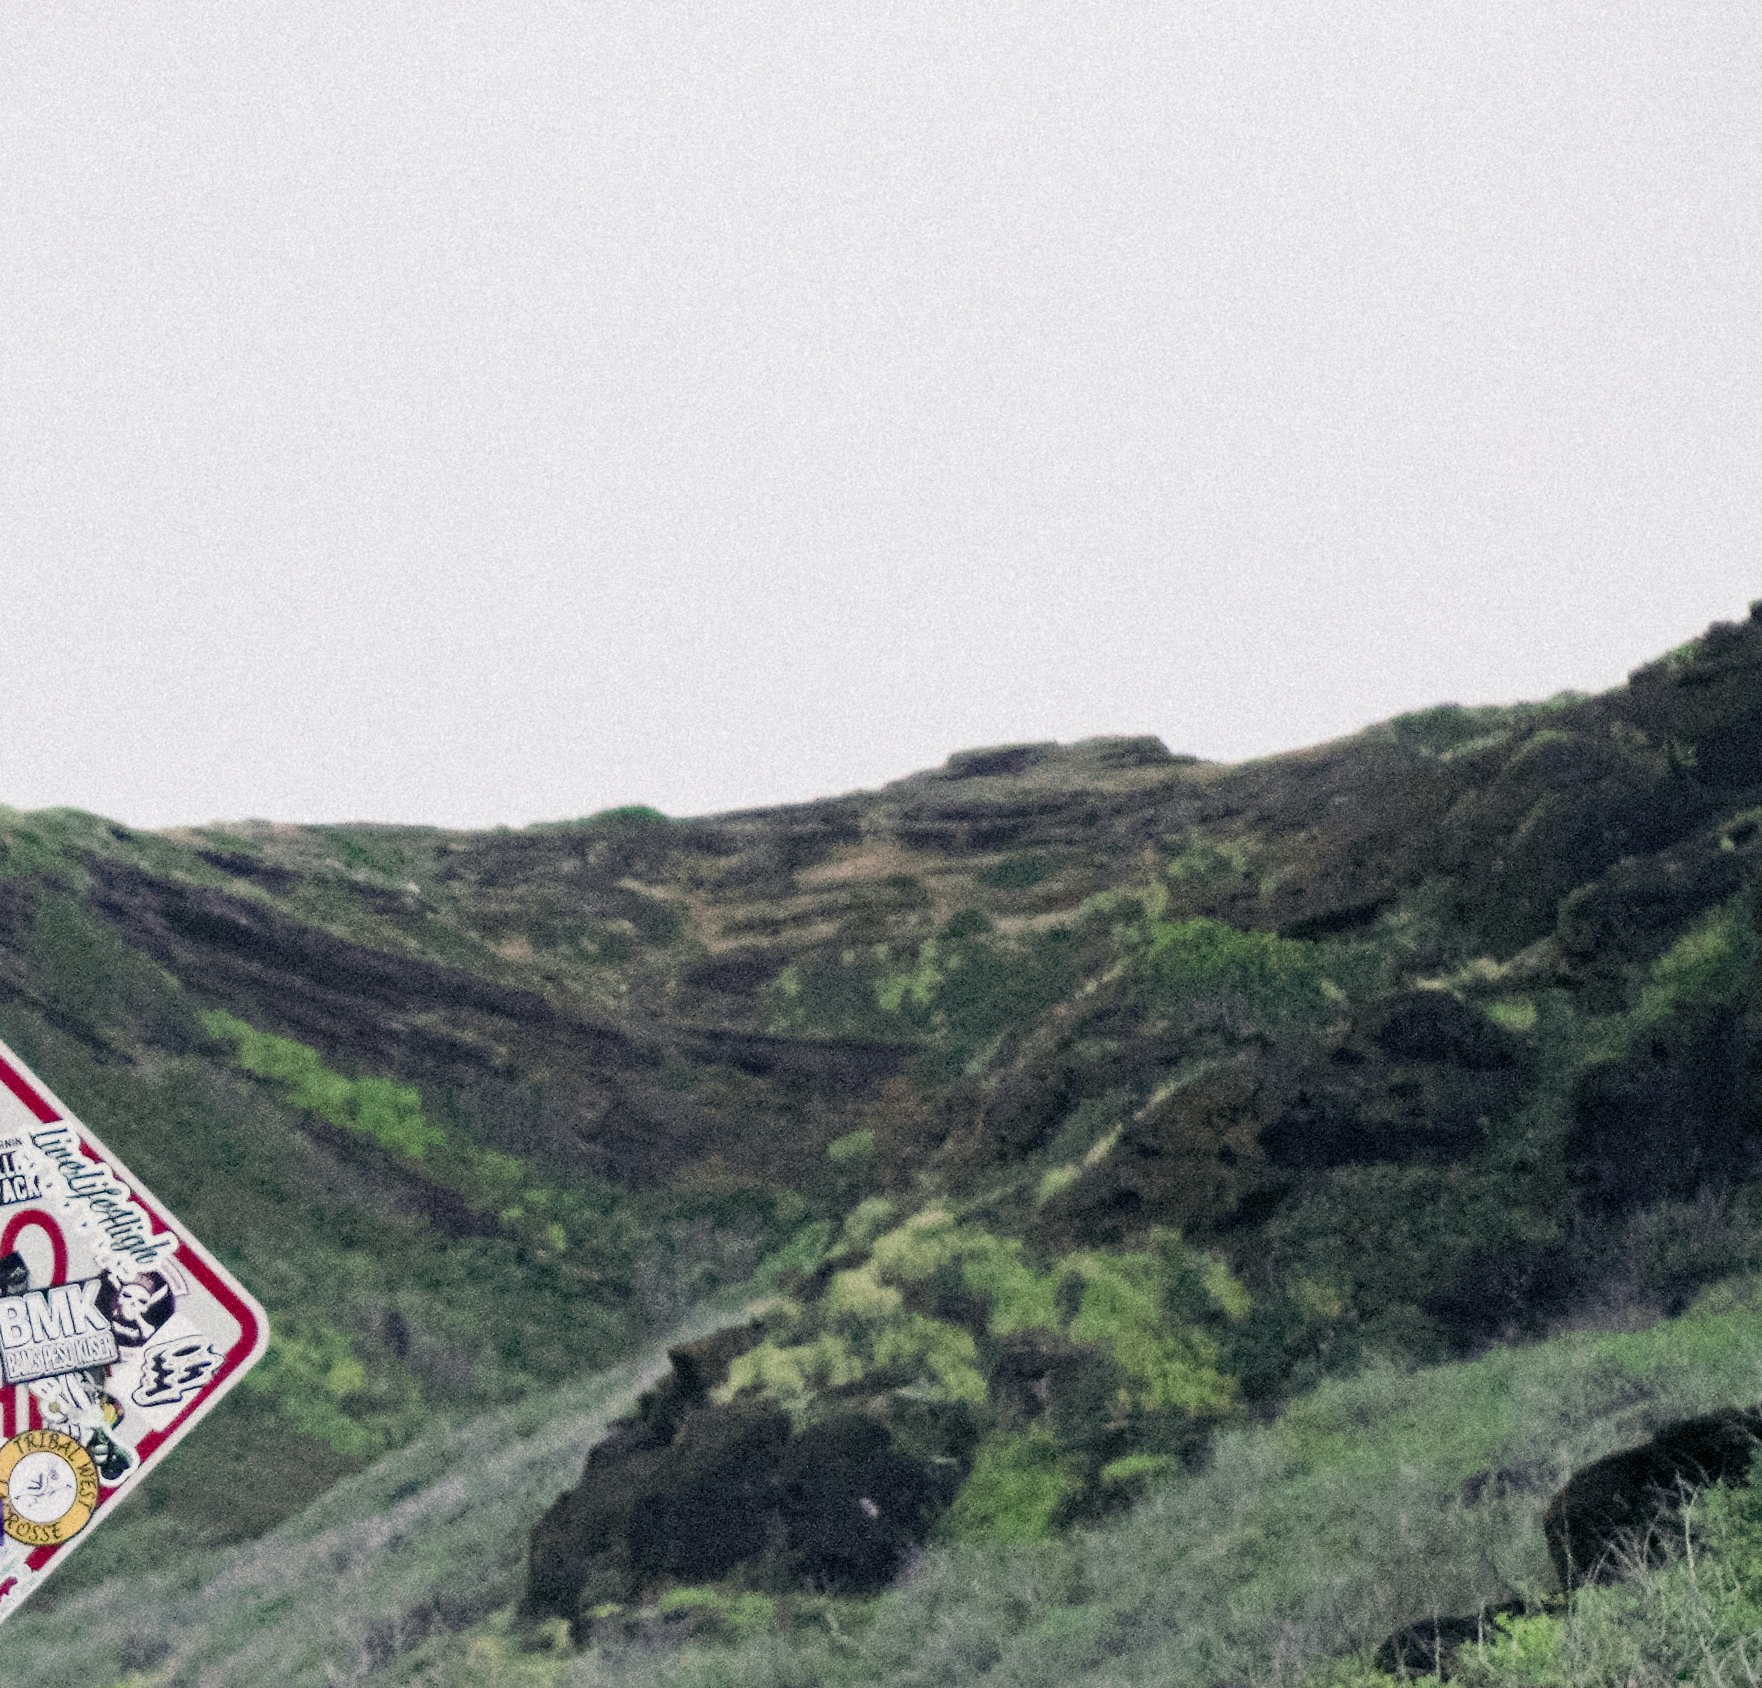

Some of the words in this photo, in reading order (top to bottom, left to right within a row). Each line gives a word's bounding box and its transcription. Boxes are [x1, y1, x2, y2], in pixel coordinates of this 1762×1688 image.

[0, 1278, 112, 1349] BMK
[13, 1432, 80, 1461] TRIBAL
[77, 1462, 96, 1507] WEST
